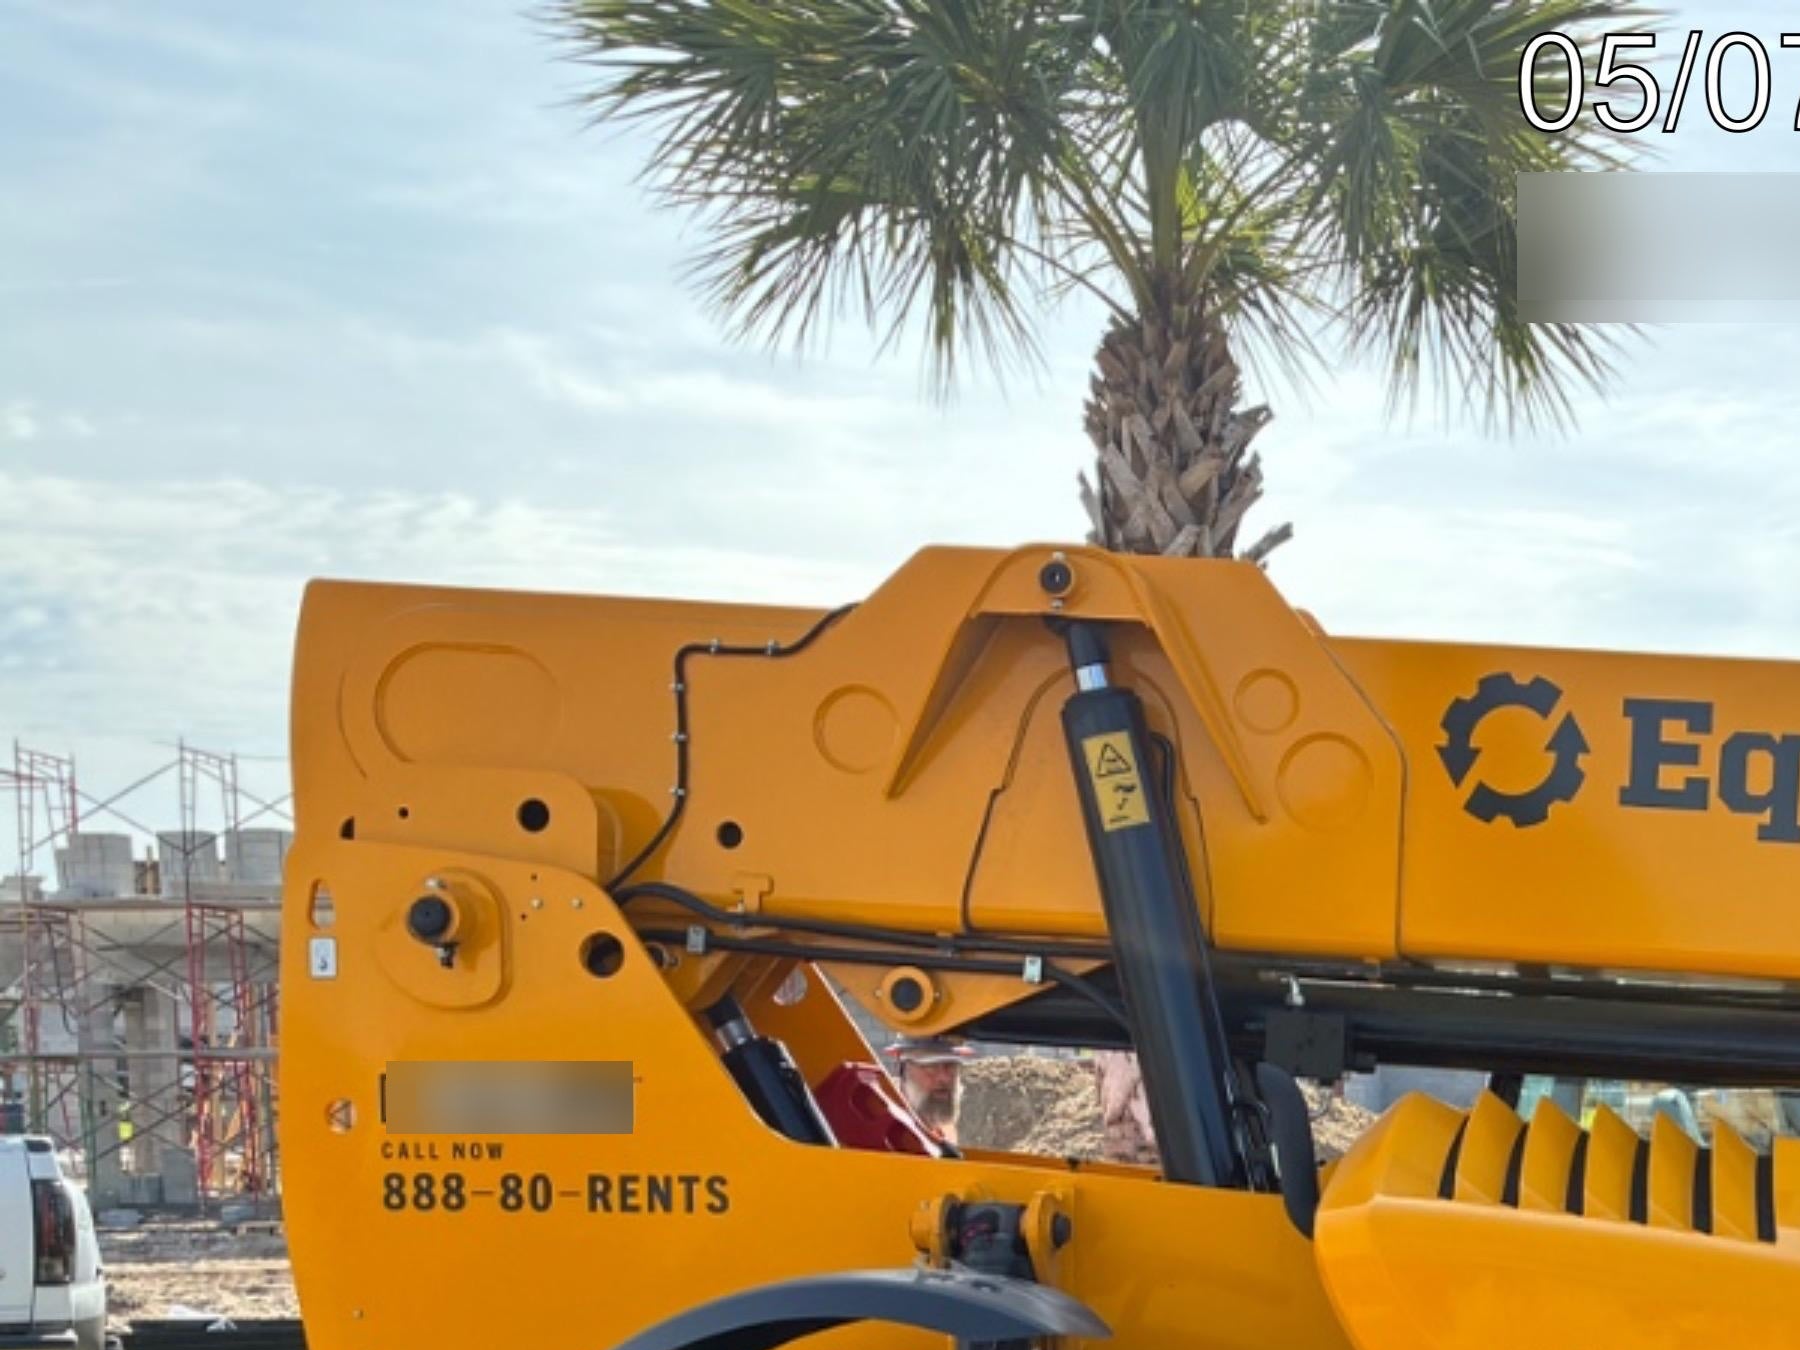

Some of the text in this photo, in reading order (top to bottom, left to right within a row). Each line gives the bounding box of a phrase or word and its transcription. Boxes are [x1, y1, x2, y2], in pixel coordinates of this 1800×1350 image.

[381, 1141, 504, 1160] CALL NOW
[383, 1172, 731, 1214] 888-80-RENTS
